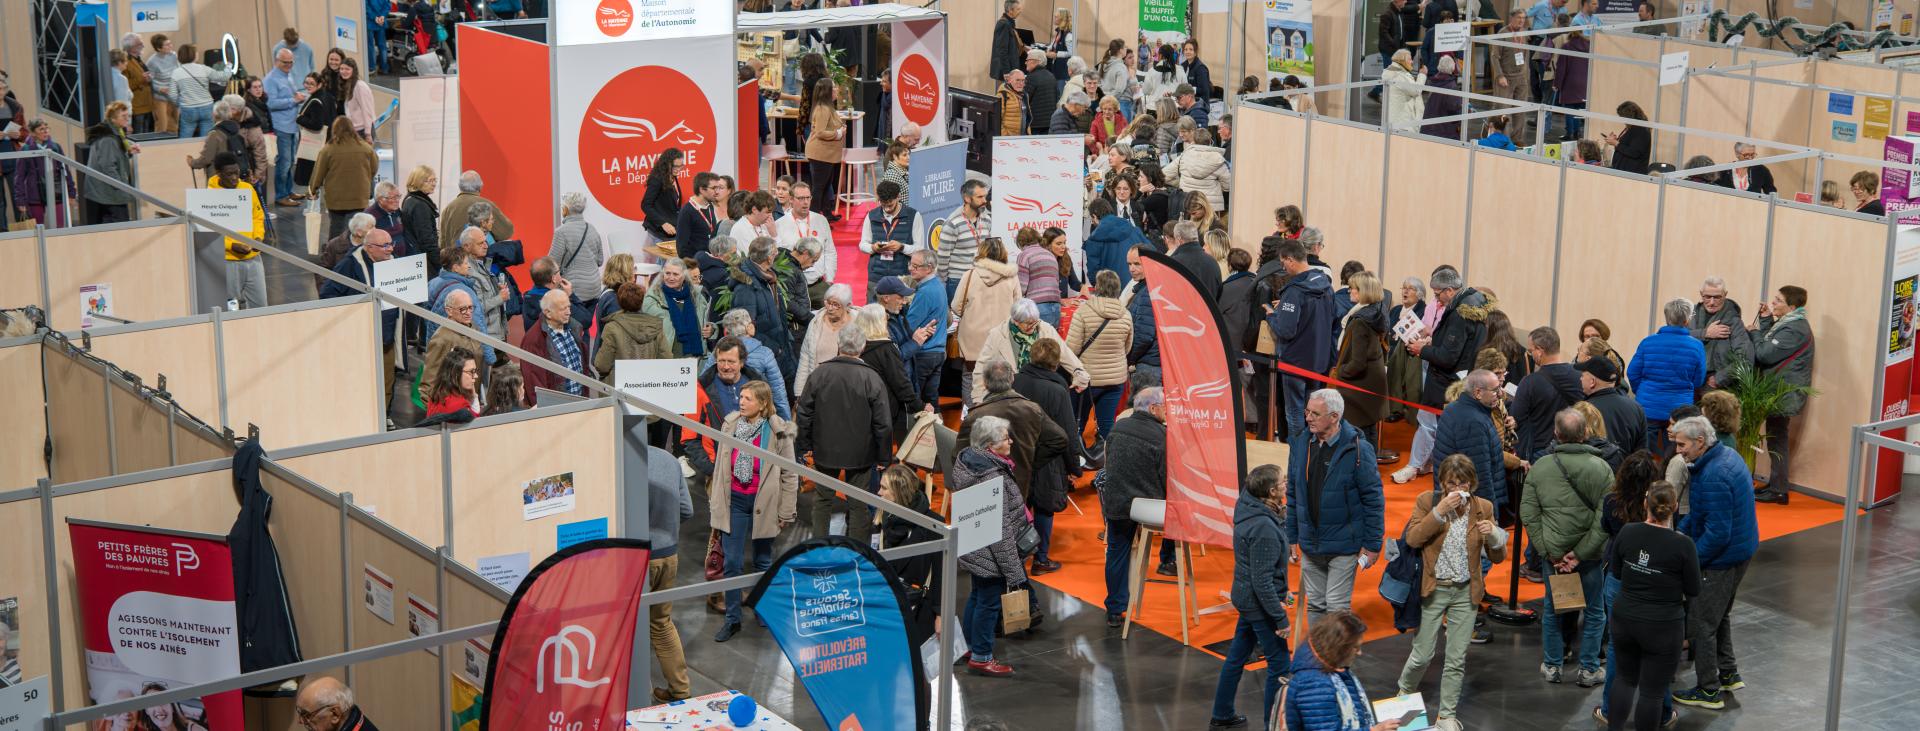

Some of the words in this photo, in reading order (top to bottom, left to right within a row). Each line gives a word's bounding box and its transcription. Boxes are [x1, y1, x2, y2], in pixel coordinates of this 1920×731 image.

[641, 8, 696, 19] départementale
[641, 20, 651, 28] de
[652, 17, 697, 28] l'Autonomie
[602, 157, 621, 174] LA
[609, 174, 621, 186] Le
[922, 178, 955, 199] M'LIRE
[930, 195, 946, 205] LAVAL
[1007, 222, 1021, 232] LA
[415, 261, 423, 269] 52
[680, 366, 691, 375] 53
[623, 381, 661, 389] Association
[992, 487, 999, 497] 54
[98, 541, 131, 553] PETITS
[133, 544, 169, 557] FRÈRES
[104, 551, 124, 562] DES
[126, 553, 169, 567] PAUVRES
[118, 614, 168, 627] AGISSONS
[169, 619, 232, 635] MAINTENANT
[118, 626, 158, 638] CONTRE
[160, 631, 221, 648] L'ISOLEMENT
[120, 639, 133, 648] DE
[136, 640, 157, 650] NOS
[23, 688, 38, 702] 50
[0, 713, 20, 726] ères
